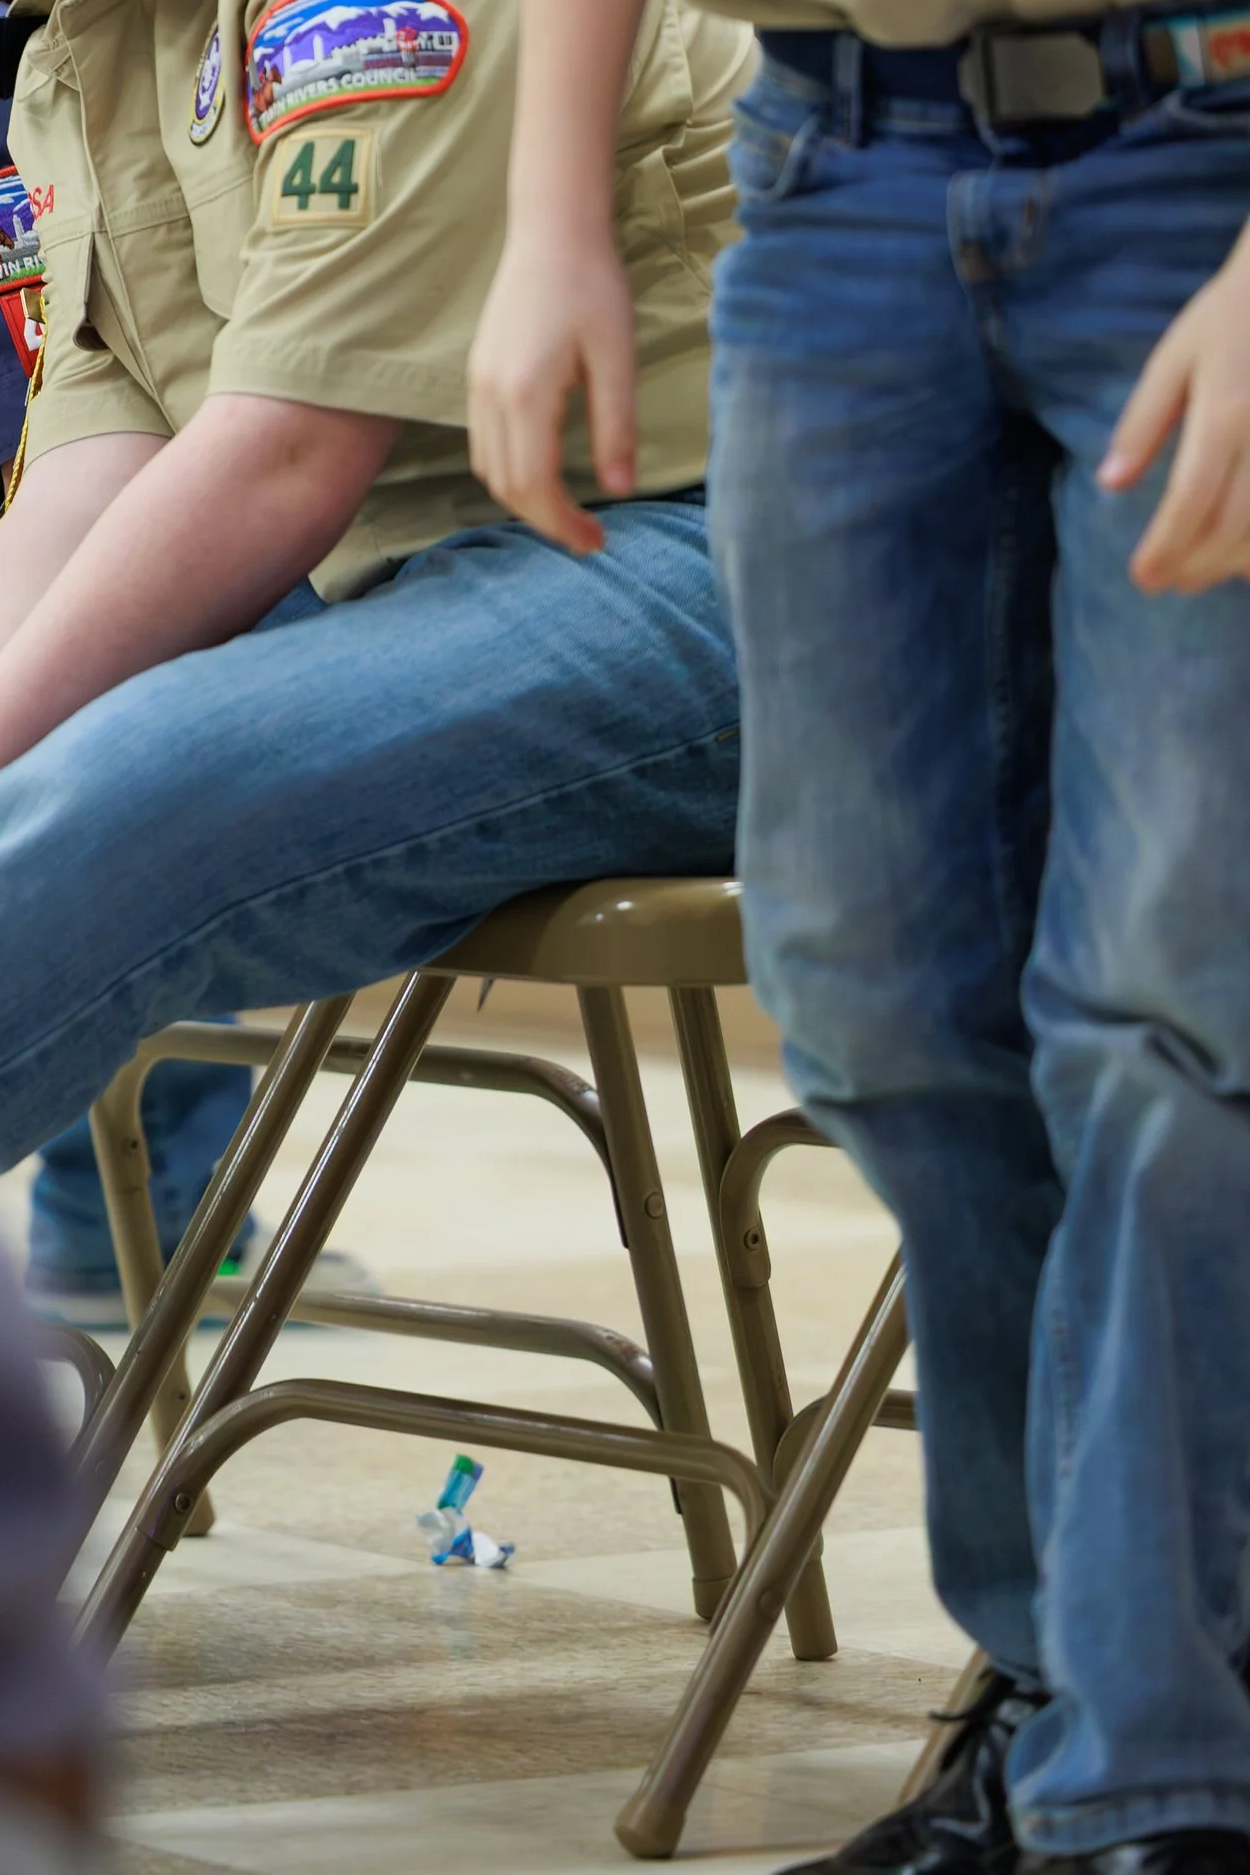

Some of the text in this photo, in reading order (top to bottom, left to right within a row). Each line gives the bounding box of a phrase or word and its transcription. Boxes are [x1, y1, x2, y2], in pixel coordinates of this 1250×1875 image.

[287, 77, 339, 105] RIVERS
[340, 67, 418, 91] COUNCIL
[281, 138, 358, 210] 44
[28, 184, 54, 220] SA
